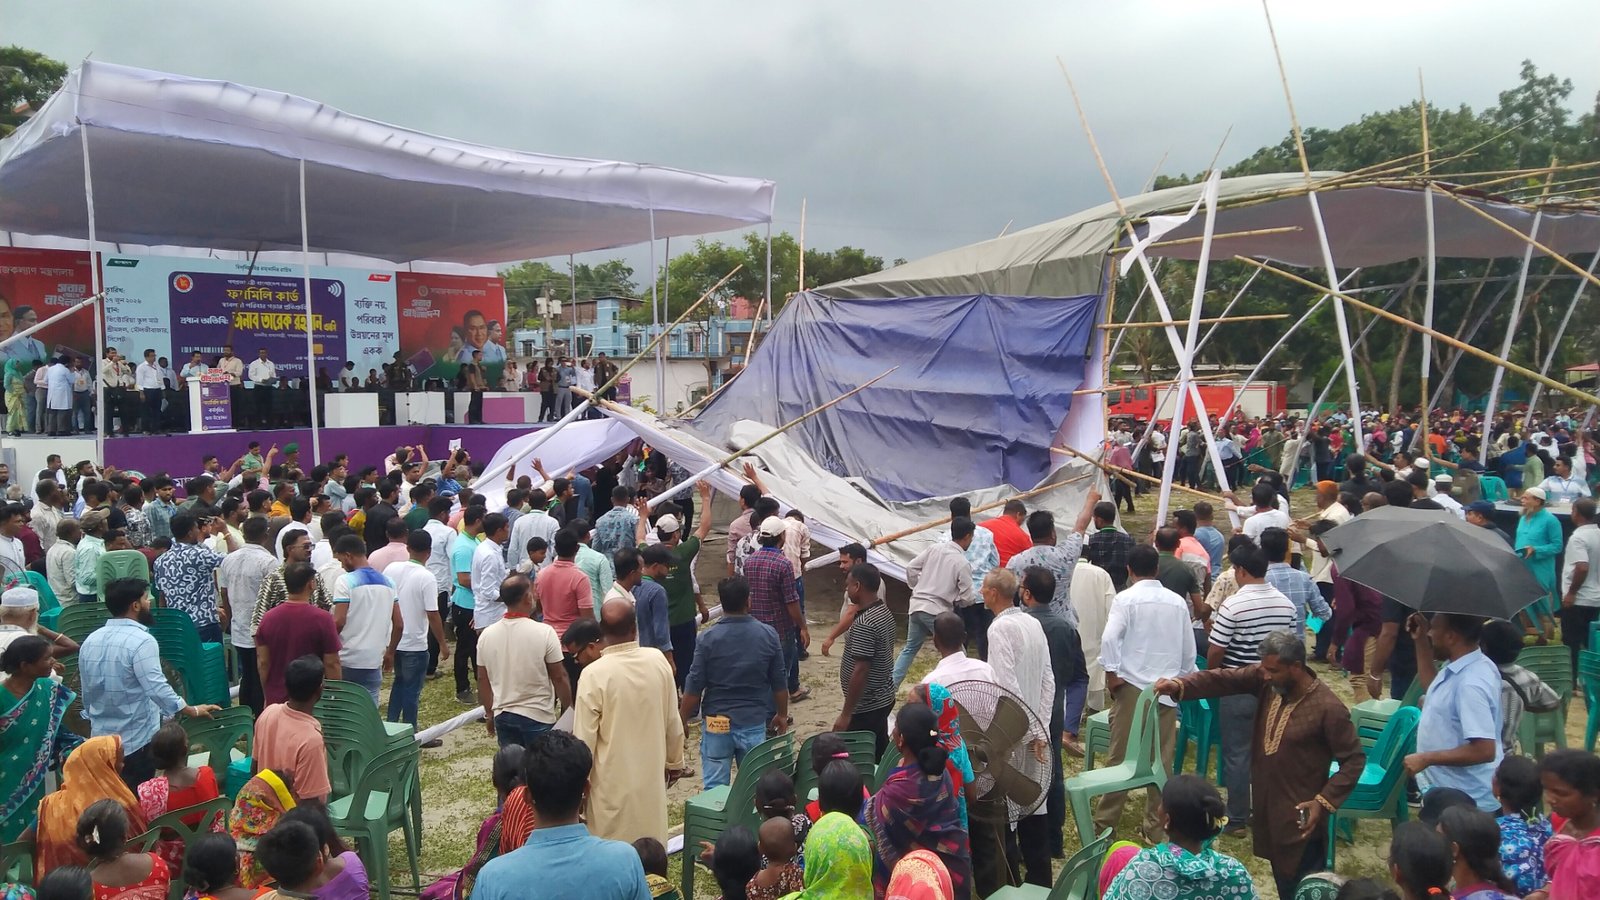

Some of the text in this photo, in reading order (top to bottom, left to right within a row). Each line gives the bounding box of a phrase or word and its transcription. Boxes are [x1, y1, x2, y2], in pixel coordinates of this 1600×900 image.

[275, 289, 300, 302] কার্ড
[354, 297, 373, 309] ব্যক্তি
[180, 316, 199, 324] প্রধান
[260, 312, 292, 331] তারেক
[293, 313, 322, 332] রহান
[356, 313, 386, 325] পরিবারই
[350, 329, 380, 340] উন্নয়নের
[382, 332, 394, 343] মূল
[363, 346, 383, 355] একক
